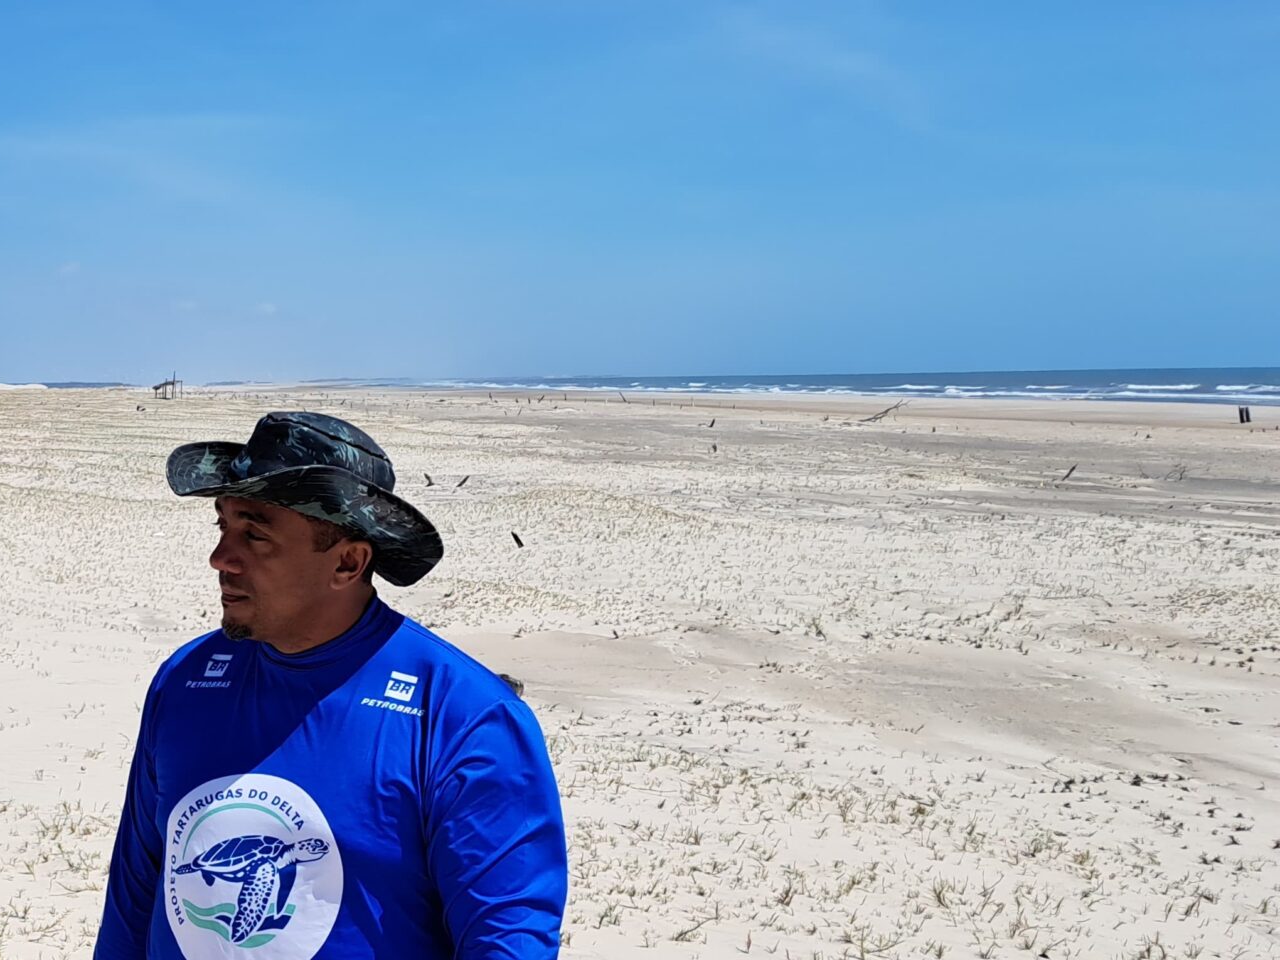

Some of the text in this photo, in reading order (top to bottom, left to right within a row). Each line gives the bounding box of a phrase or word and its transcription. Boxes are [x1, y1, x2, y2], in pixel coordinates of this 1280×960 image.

[185, 680, 231, 689] PETROBRAS
[360, 697, 426, 717] PETROBRAS
[170, 788, 305, 926] PROJETO TARTARUGAS DO DELTA
